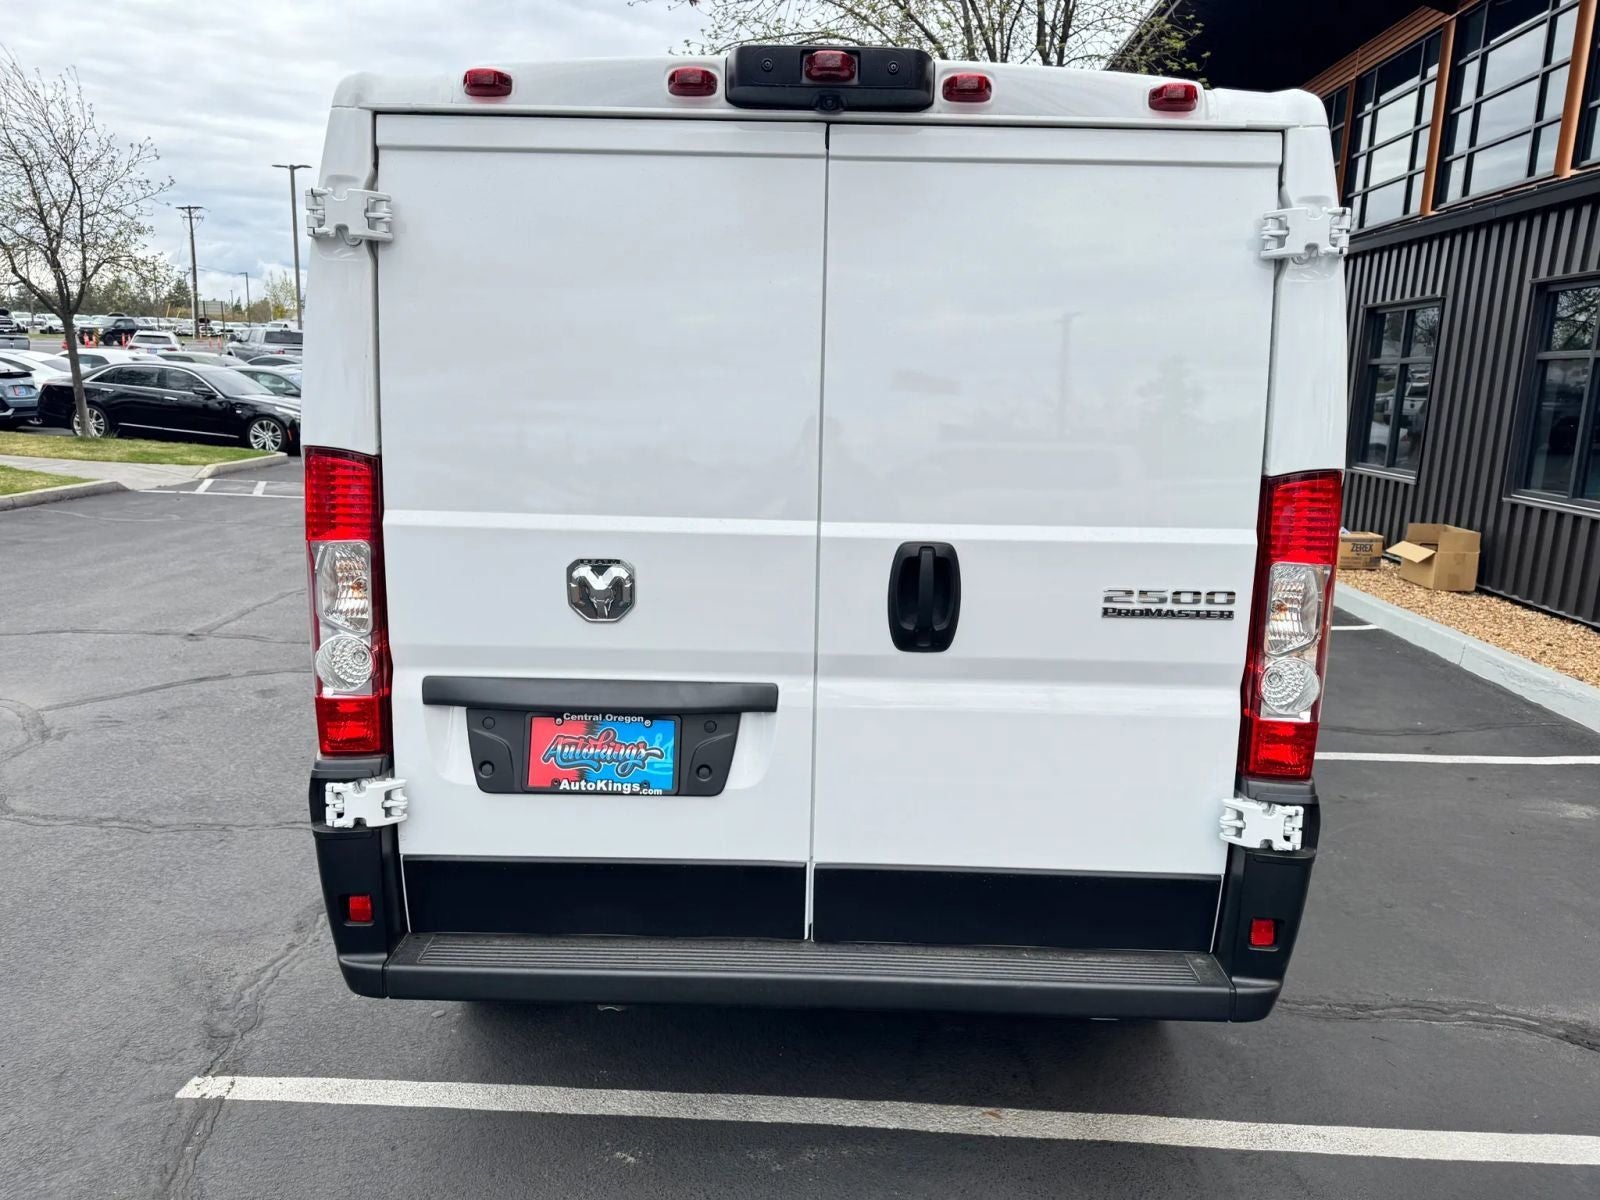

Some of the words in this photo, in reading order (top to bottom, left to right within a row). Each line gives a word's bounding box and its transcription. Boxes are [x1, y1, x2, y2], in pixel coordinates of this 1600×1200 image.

[1351, 543, 1374, 553] ZEREX
[1103, 589, 1236, 605] 2500
[563, 712, 602, 722] Central
[604, 713, 644, 724] Oregon
[559, 778, 663, 796] AutoKings.com
